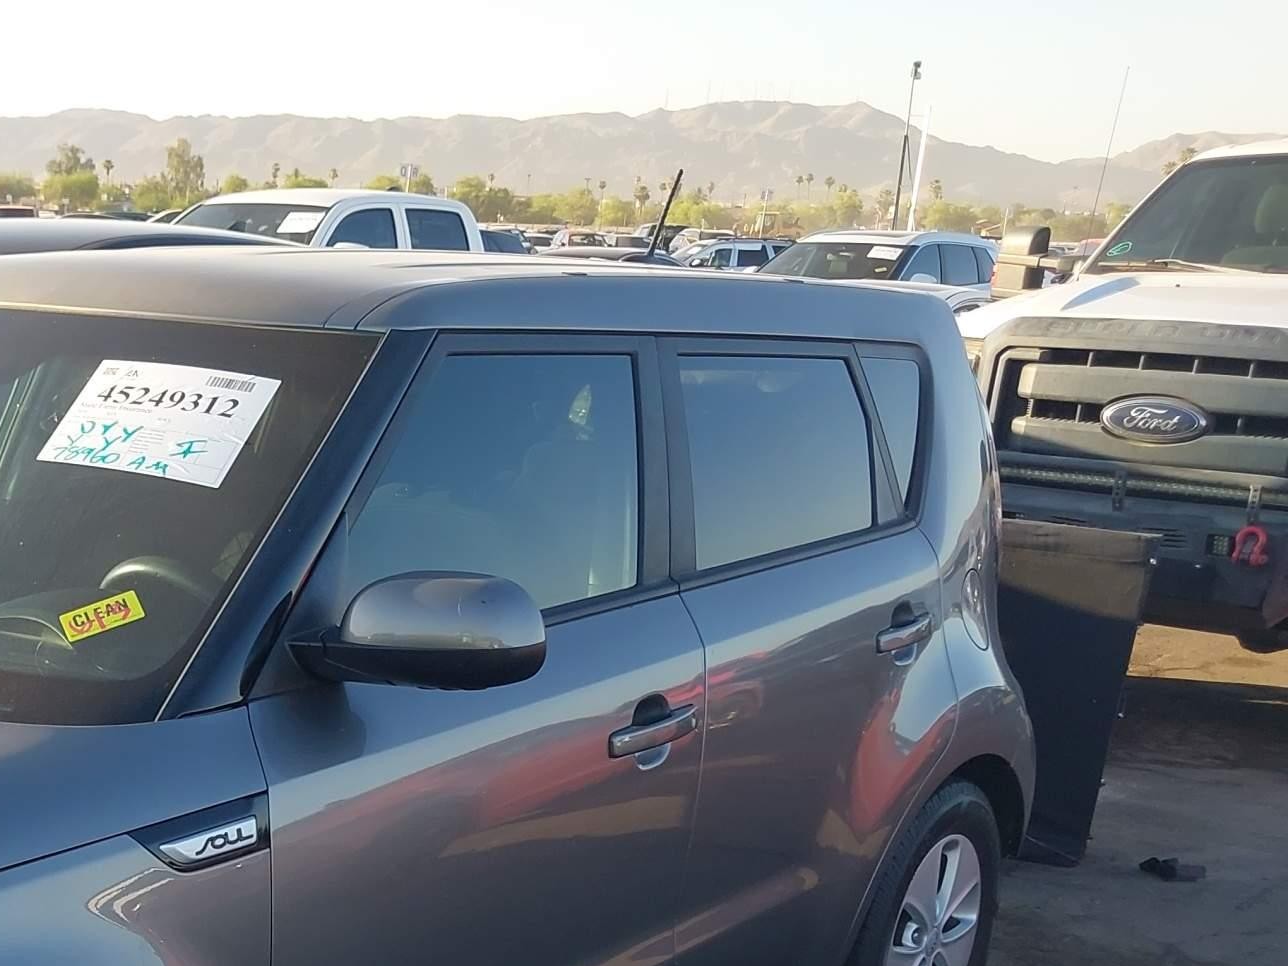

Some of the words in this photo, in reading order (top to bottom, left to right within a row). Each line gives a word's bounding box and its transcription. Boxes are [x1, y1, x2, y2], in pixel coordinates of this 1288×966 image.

[97, 384, 240, 418] 45249312
[1123, 406, 1181, 431] Ford
[72, 597, 130, 628] CLEAN
